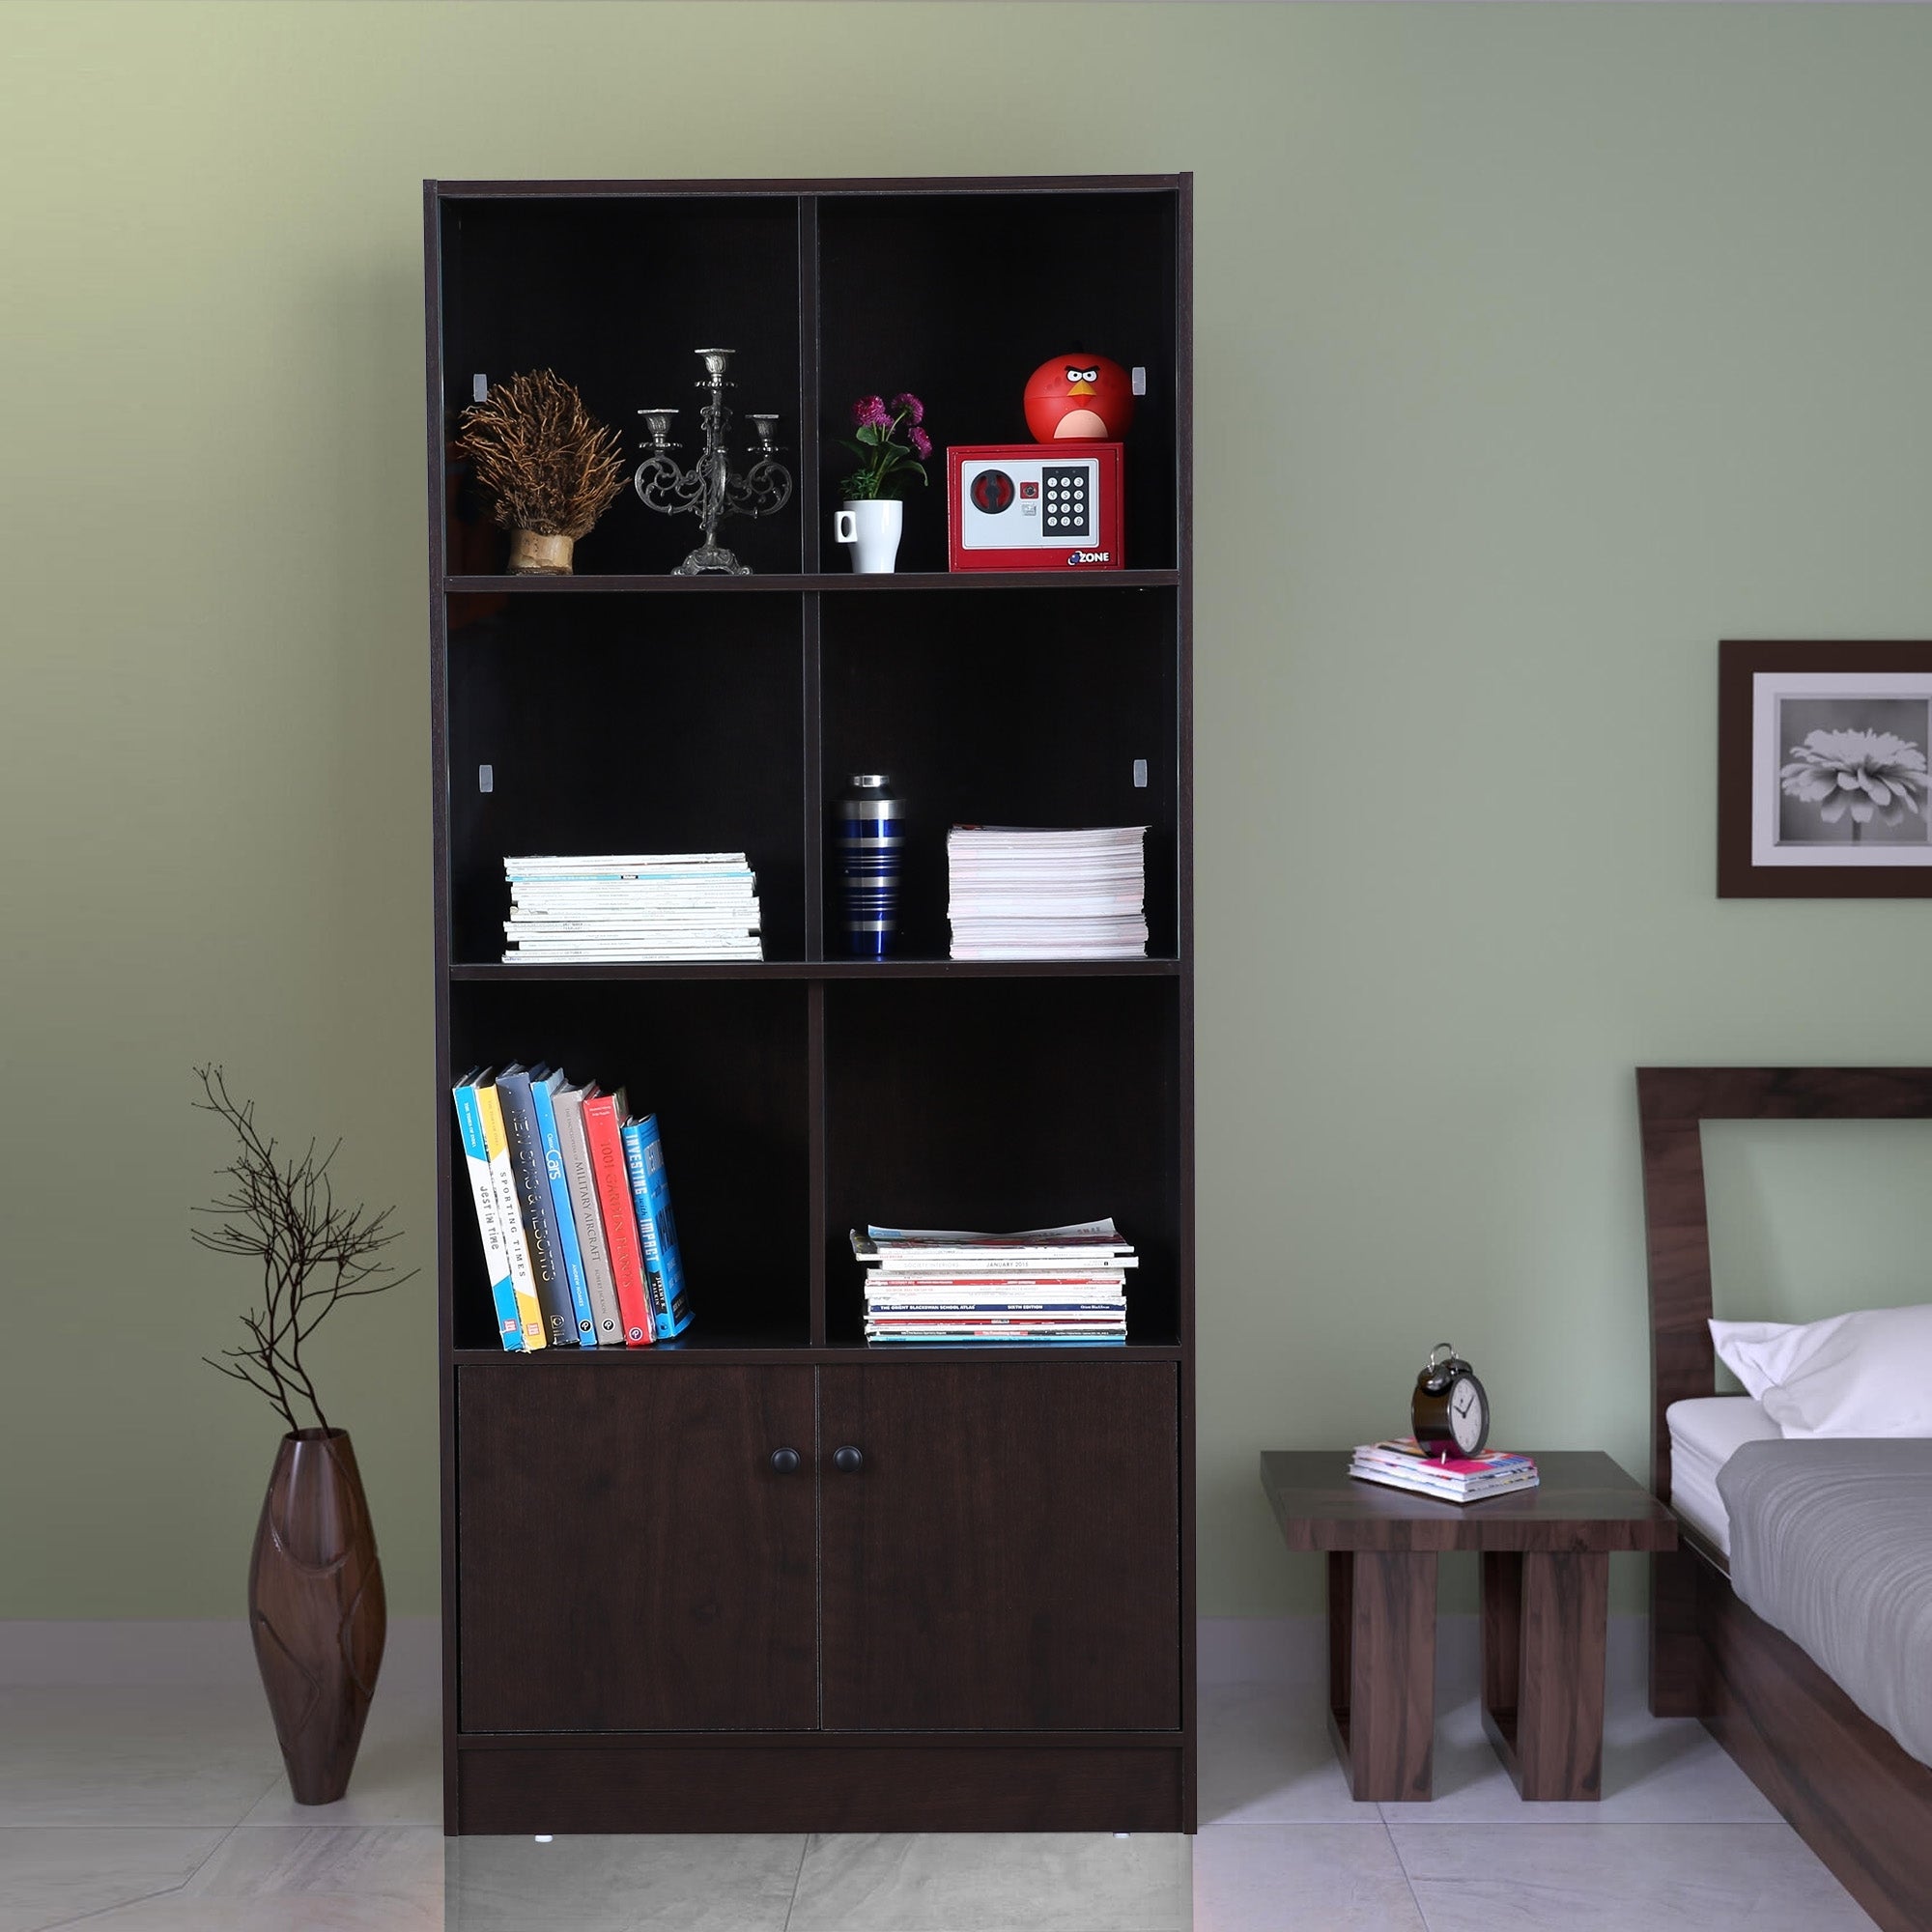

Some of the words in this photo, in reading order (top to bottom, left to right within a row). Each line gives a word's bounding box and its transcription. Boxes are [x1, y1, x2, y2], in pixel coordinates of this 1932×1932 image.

[511, 1108, 532, 1147] NEW
[519, 1150, 540, 1191] SPAS
[545, 1149, 562, 1180] Cars
[600, 1141, 615, 1169] 1001
[625, 1133, 647, 1195] INVESTING
[526, 1192, 543, 1206] &
[575, 1161, 591, 1210] MILITARY
[584, 1212, 601, 1262] AIRCRAFT
[605, 1173, 625, 1231] GARDEN
[638, 1197, 648, 1216] with
[499, 1172, 518, 1234] SPORTING
[513, 1239, 526, 1277] TIMES
[529, 1208, 557, 1282] RESORTS
[639, 1217, 659, 1264] IMPACT
[616, 1236, 635, 1289] PLANTS
[656, 1276, 665, 1301] JEREMY
